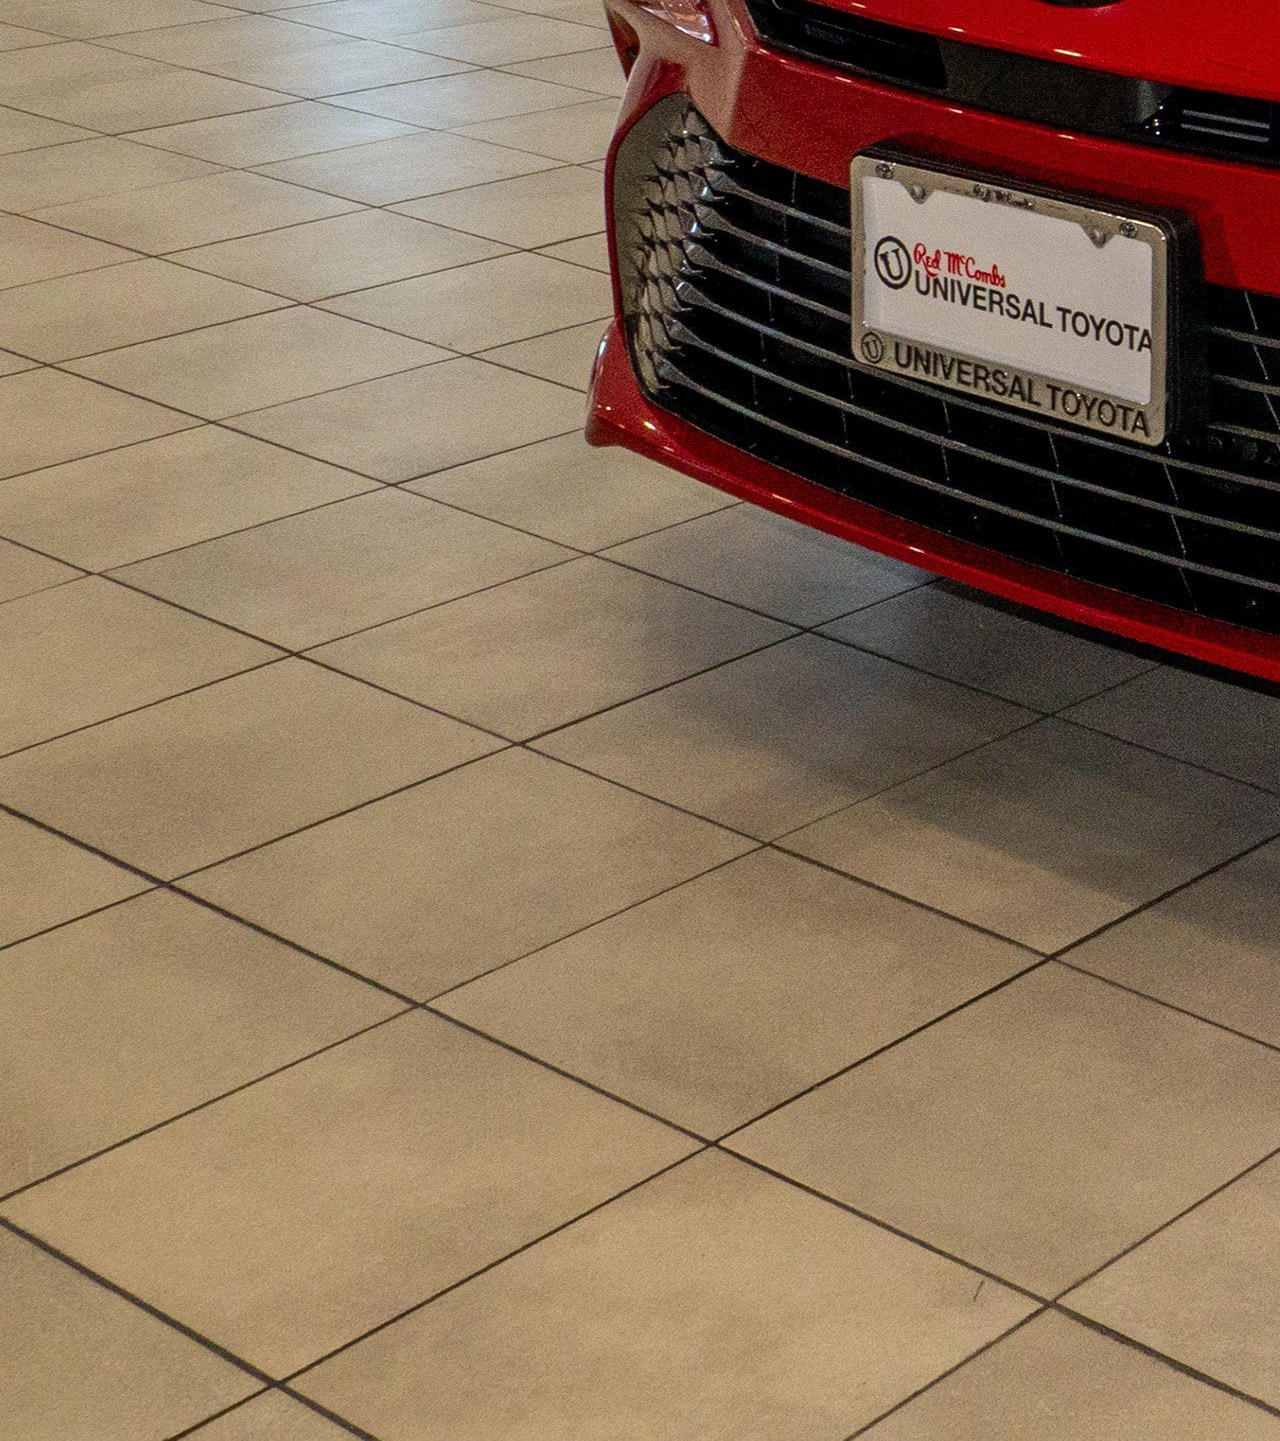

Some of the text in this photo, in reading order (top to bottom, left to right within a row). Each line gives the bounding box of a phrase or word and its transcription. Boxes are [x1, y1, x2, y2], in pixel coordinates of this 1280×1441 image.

[913, 243, 941, 277] Red
[915, 270, 1152, 353] UNIVERSAL TOYOTA
[895, 344, 1042, 407] UNIVERSAL
[1047, 384, 1150, 438] TOYOTA
